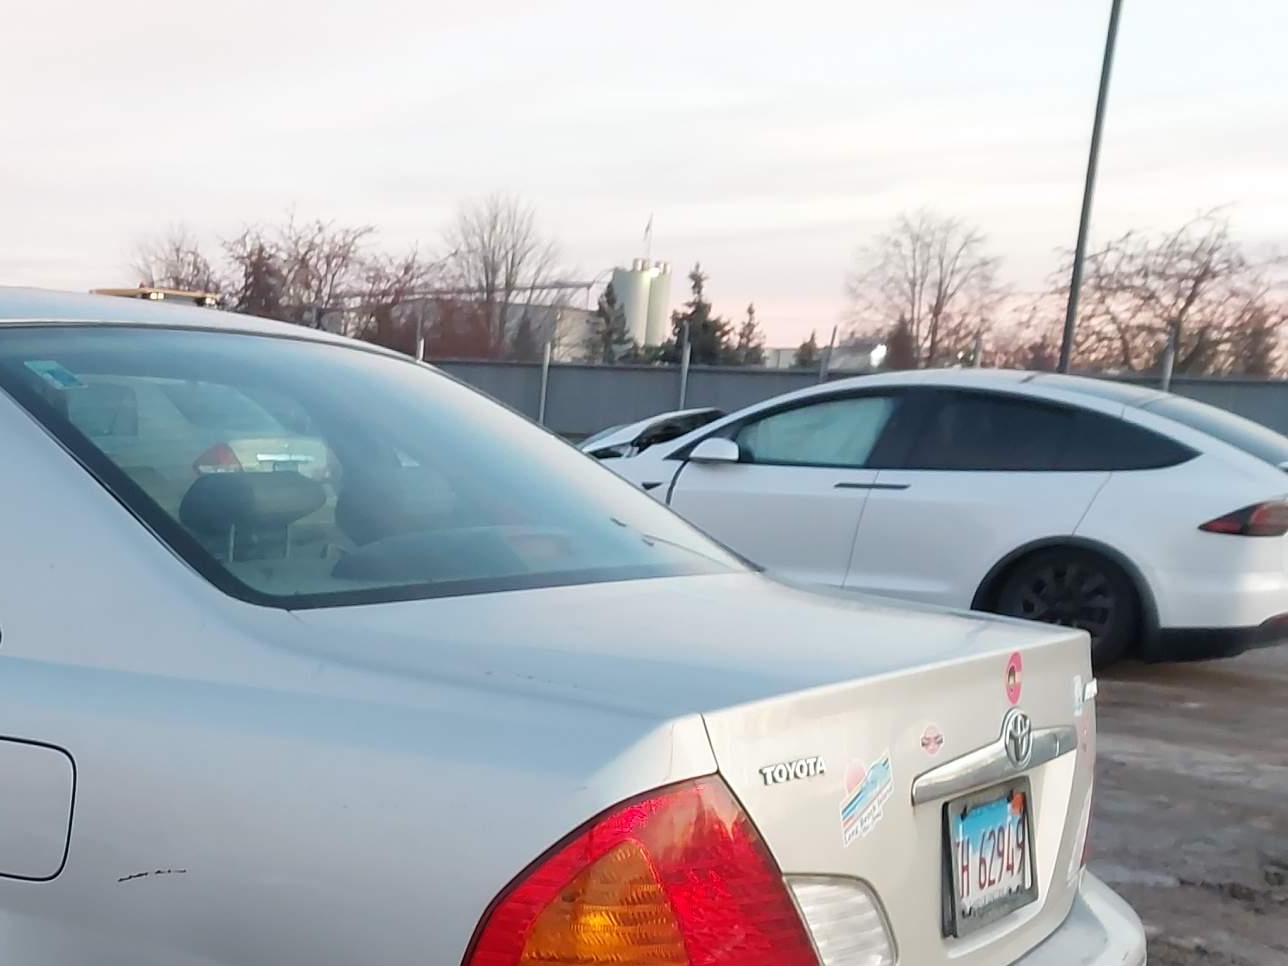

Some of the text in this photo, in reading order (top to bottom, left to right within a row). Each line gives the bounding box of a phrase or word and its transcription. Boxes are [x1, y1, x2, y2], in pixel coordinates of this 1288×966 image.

[759, 756, 826, 786] TOYOTA
[955, 834, 971, 899] H
[978, 812, 1026, 891] 62949
